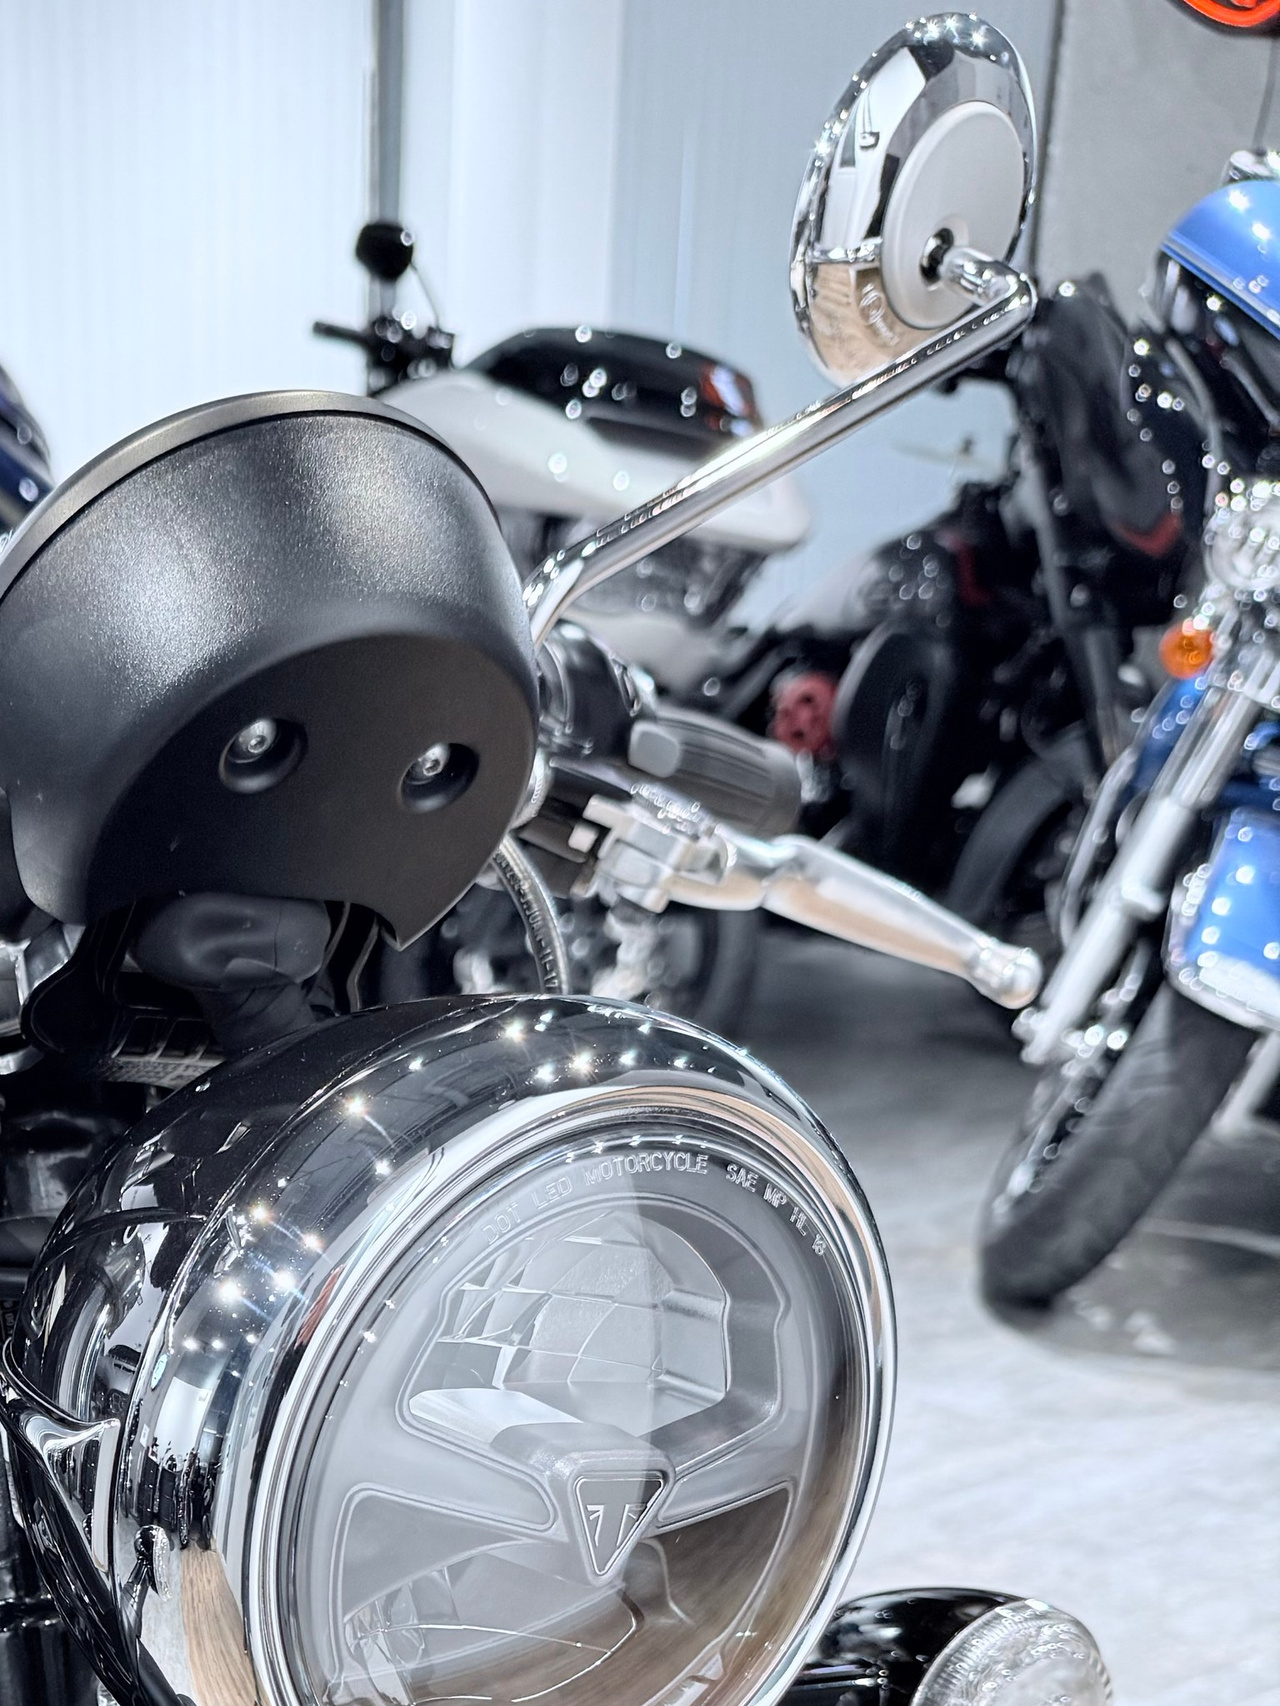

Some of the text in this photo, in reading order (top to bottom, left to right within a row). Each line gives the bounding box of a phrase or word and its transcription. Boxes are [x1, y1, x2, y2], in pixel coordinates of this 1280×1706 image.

[530, 1176, 572, 1210] LED
[583, 1150, 709, 1187] MOTORCYCLE
[725, 1163, 759, 1193] SAE
